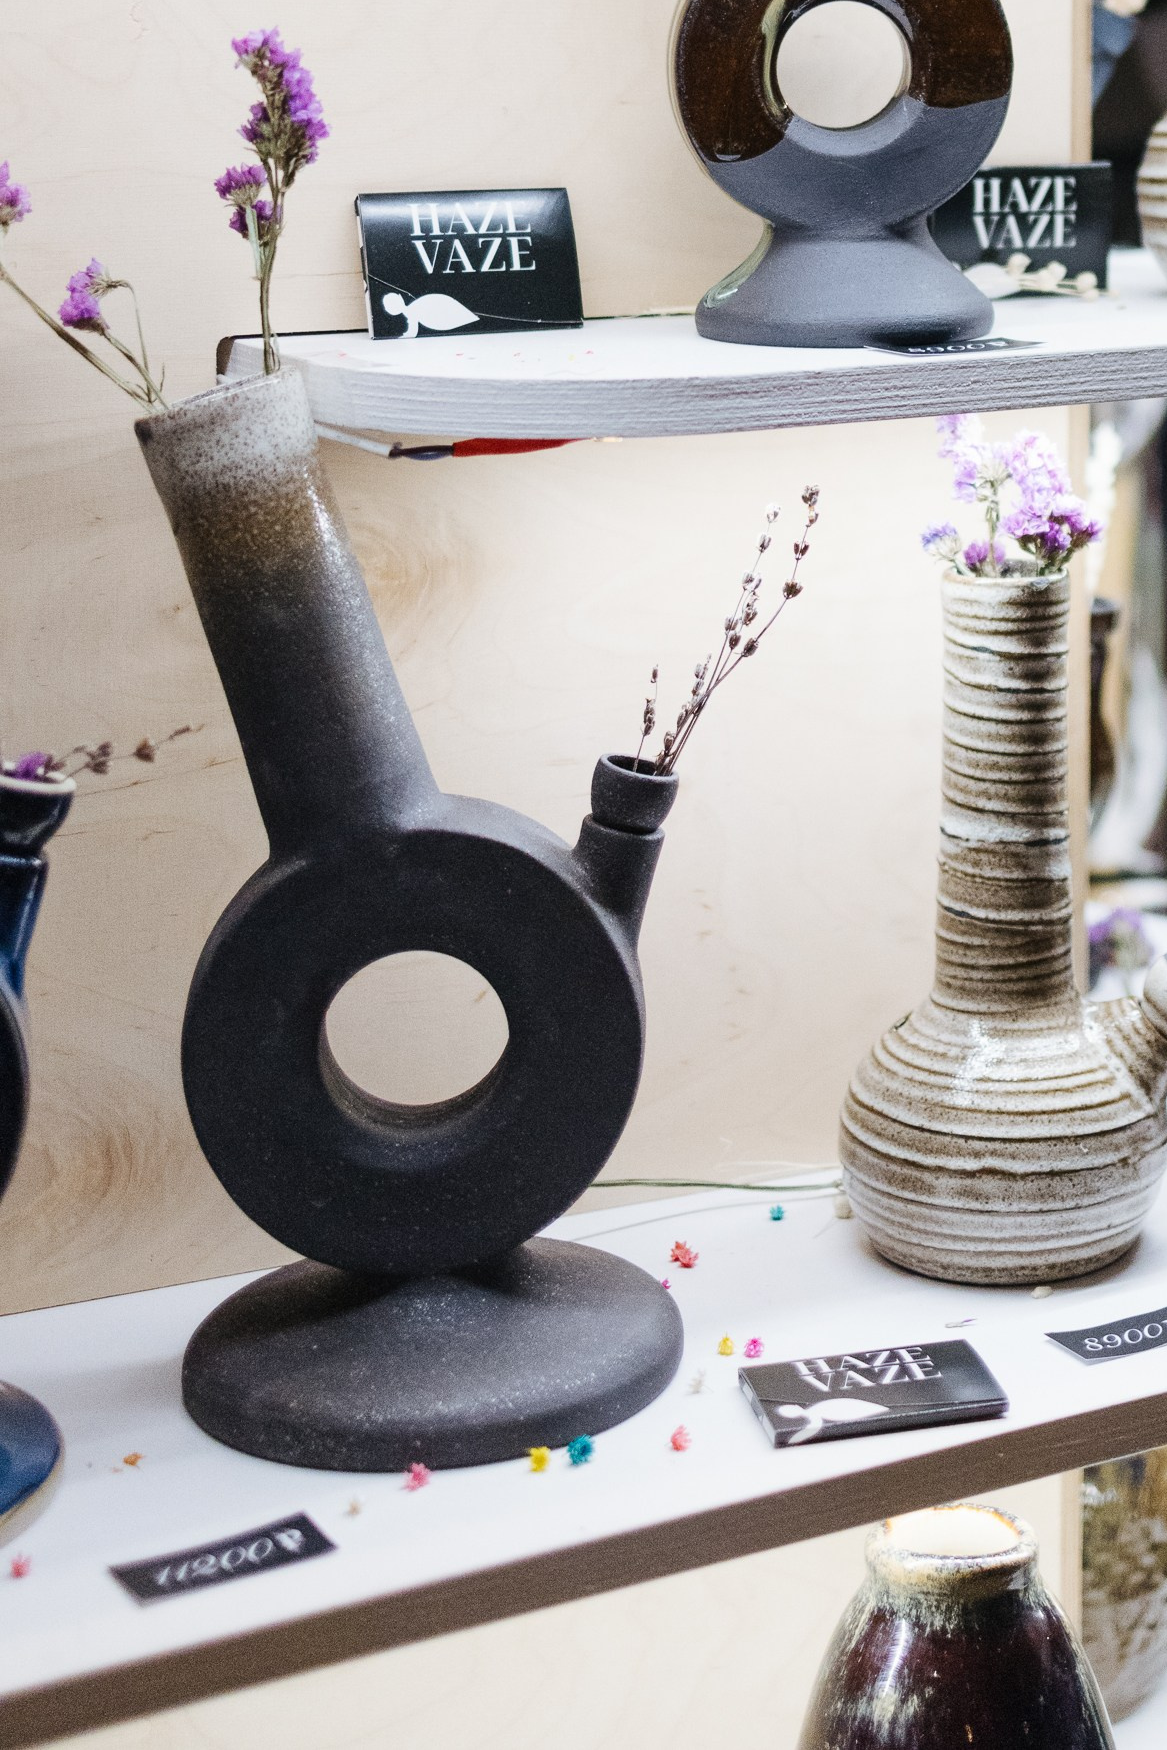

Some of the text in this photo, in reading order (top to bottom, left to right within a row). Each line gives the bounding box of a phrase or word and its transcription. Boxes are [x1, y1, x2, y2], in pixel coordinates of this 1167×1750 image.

[973, 176, 1078, 213] HAZE
[408, 201, 532, 236] HAZE
[973, 213, 1077, 249] VAZE
[411, 236, 536, 275] VAZE
[791, 1346, 932, 1377] HAZE
[799, 1360, 943, 1392] VAZE
